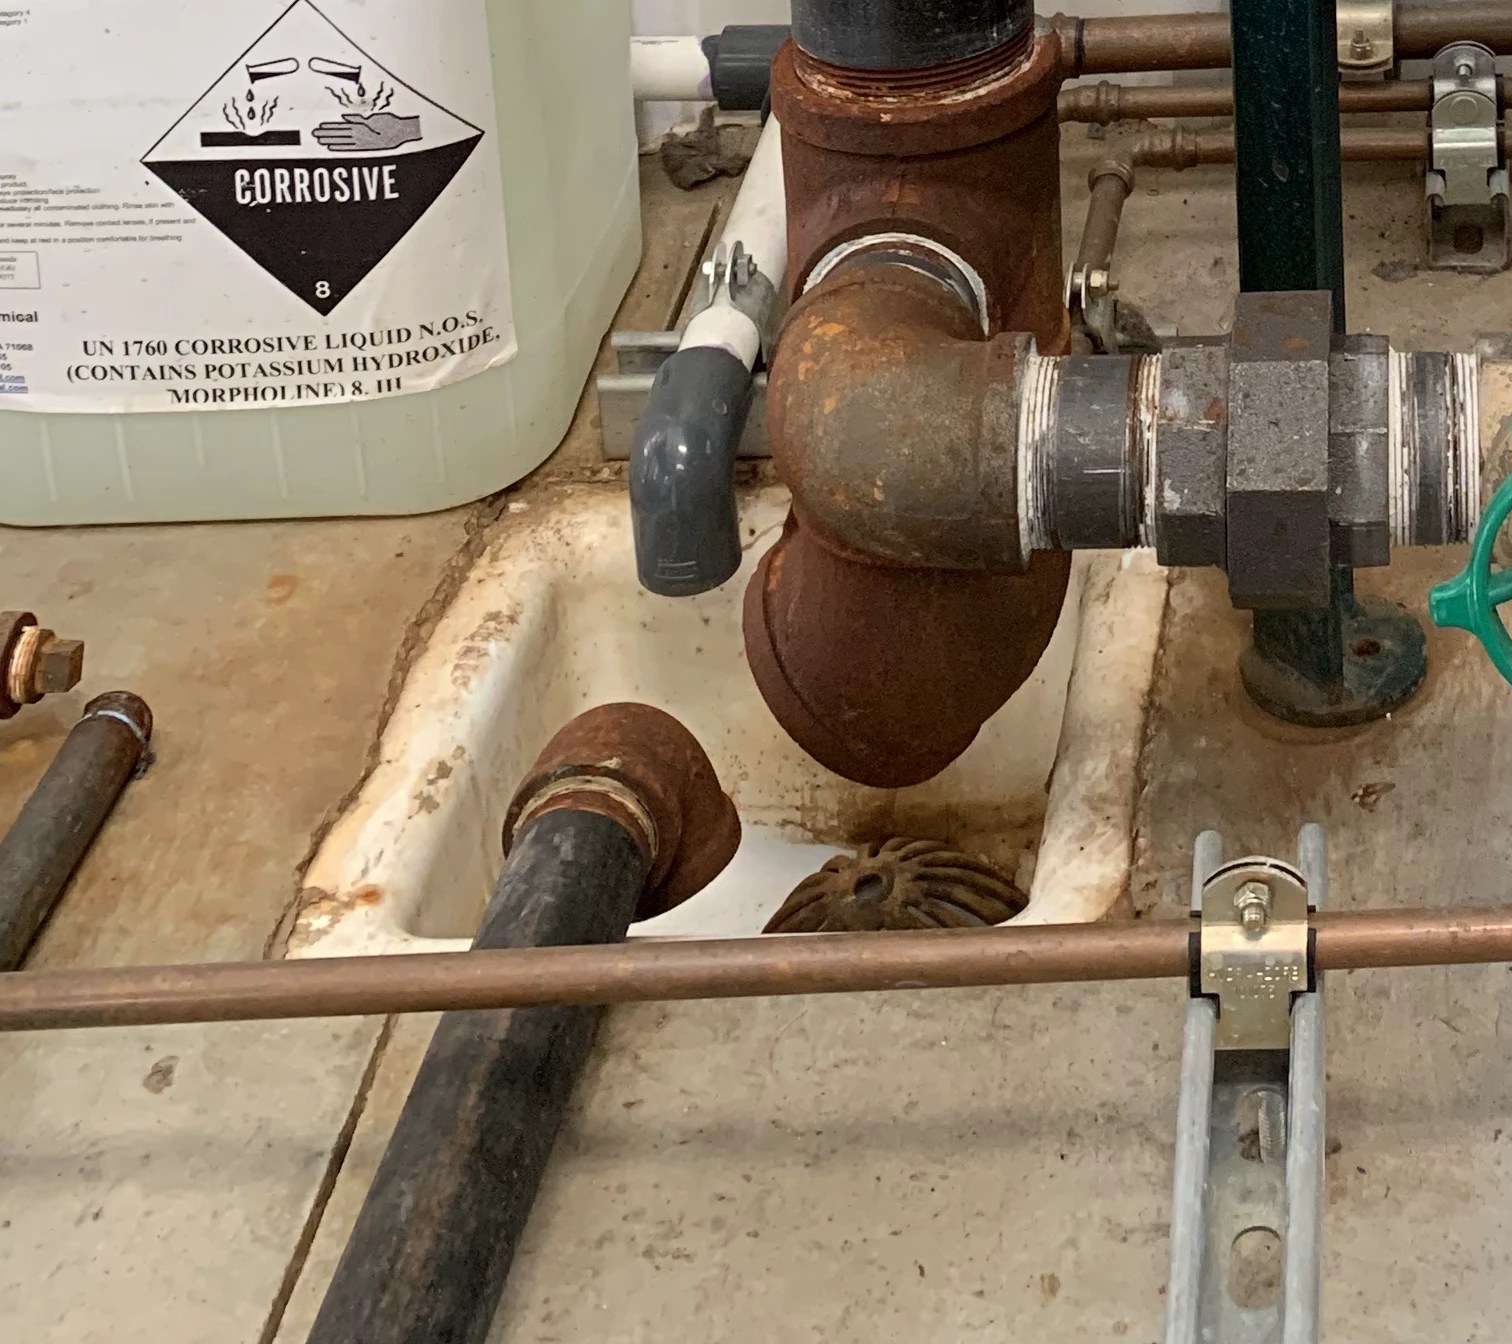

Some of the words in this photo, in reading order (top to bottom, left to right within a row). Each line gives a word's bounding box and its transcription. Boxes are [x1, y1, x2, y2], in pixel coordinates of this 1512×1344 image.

[234, 164, 399, 205] CORROSIVE
[315, 280, 331, 298] 8
[83, 340, 115, 357] UN
[122, 340, 168, 356] 1760
[175, 335, 317, 356] CORROSIVE
[325, 327, 411, 351] LIQUID
[419, 310, 483, 340] N.O.S.
[67, 364, 197, 384] (CONTAINS
[205, 358, 344, 379] POTASSIUM
[352, 326, 500, 372] HYDROXIDE,
[167, 382, 345, 404] MORPHOLINE)
